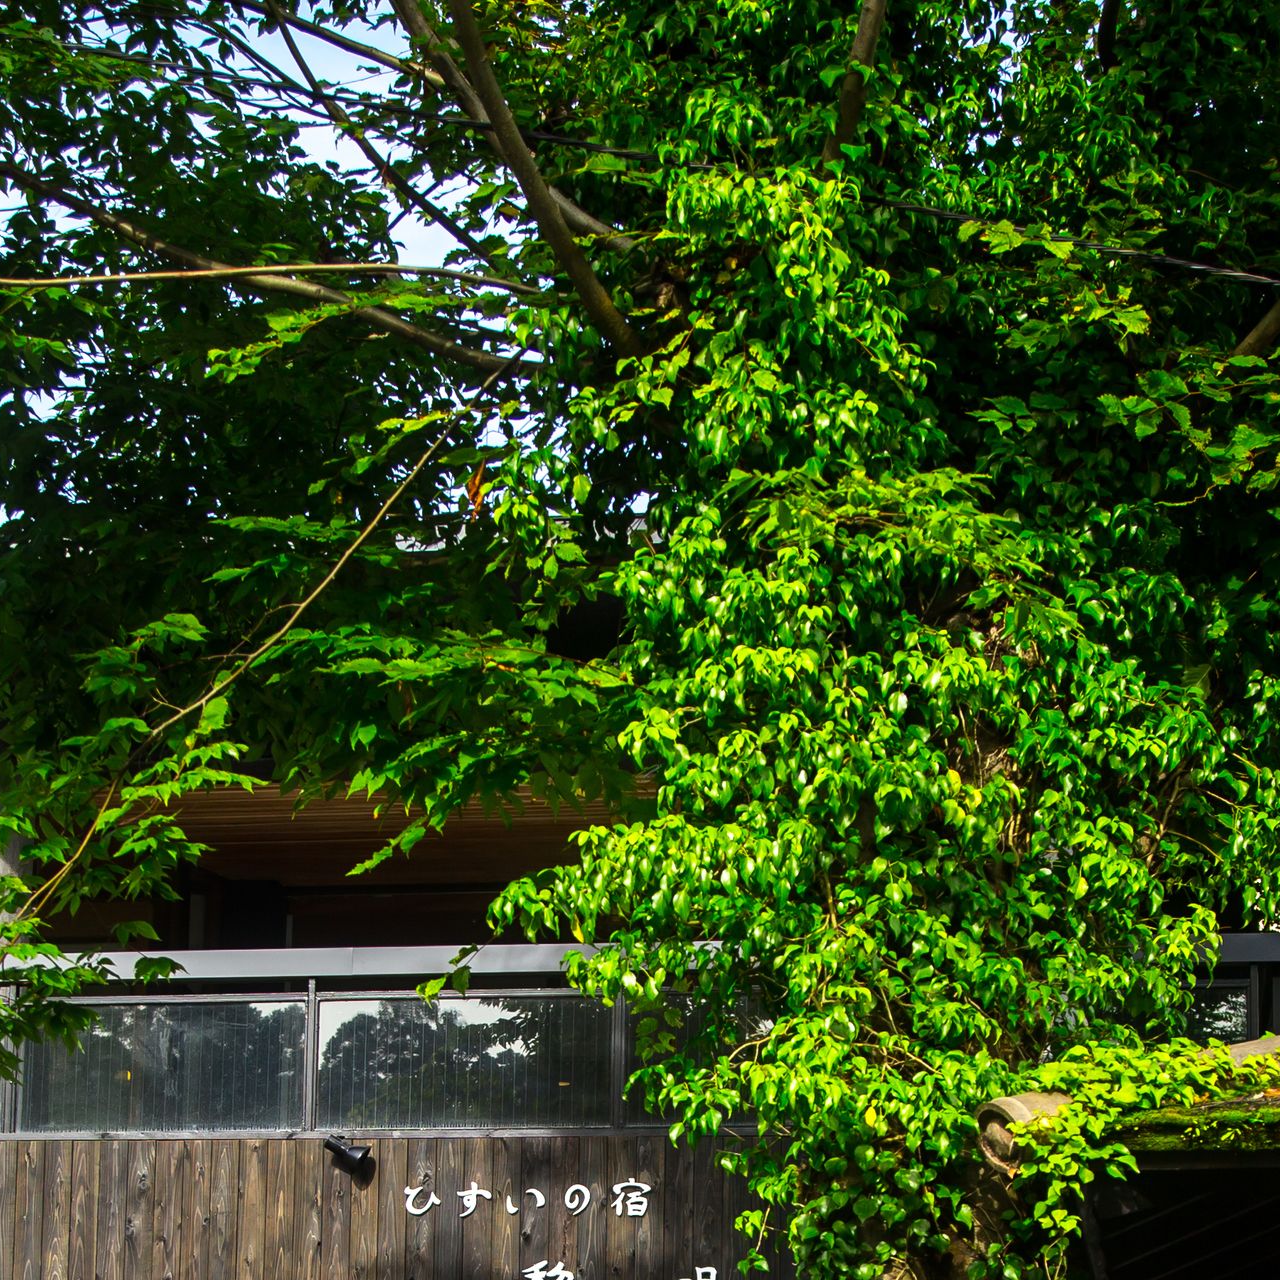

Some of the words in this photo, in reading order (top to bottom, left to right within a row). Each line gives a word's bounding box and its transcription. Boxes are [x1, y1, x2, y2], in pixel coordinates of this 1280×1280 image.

[404, 1177, 652, 1218] ひすいの宿
